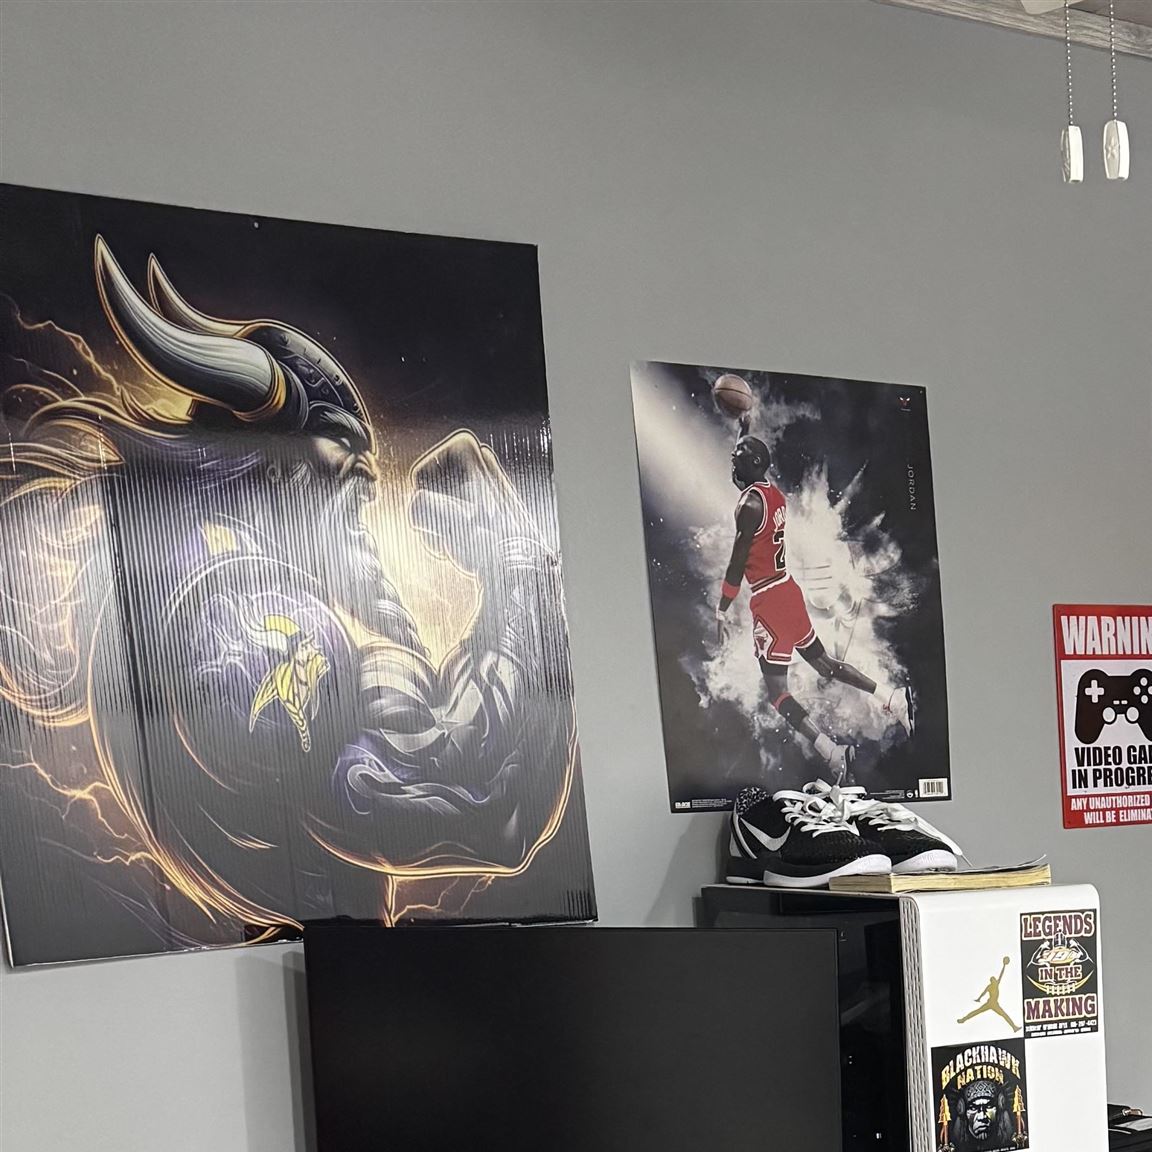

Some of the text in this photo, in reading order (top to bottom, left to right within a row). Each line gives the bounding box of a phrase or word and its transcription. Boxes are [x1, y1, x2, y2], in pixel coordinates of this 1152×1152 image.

[907, 463, 917, 511] JORDAN
[1074, 745, 1123, 767] VIDEO
[1071, 768, 1089, 789] IN
[1070, 797, 1088, 811] ANY
[1089, 793, 1150, 810] UNAUTHORIZED
[1083, 811, 1104, 825] WILL
[1105, 810, 1117, 823] BE
[1022, 911, 1094, 939] LEGENDS
[1039, 964, 1082, 981] IN THE
[1024, 994, 1097, 1023] MAKING
[941, 1045, 1021, 1090] BLACKHAWK
[956, 1064, 1005, 1089] NATION
